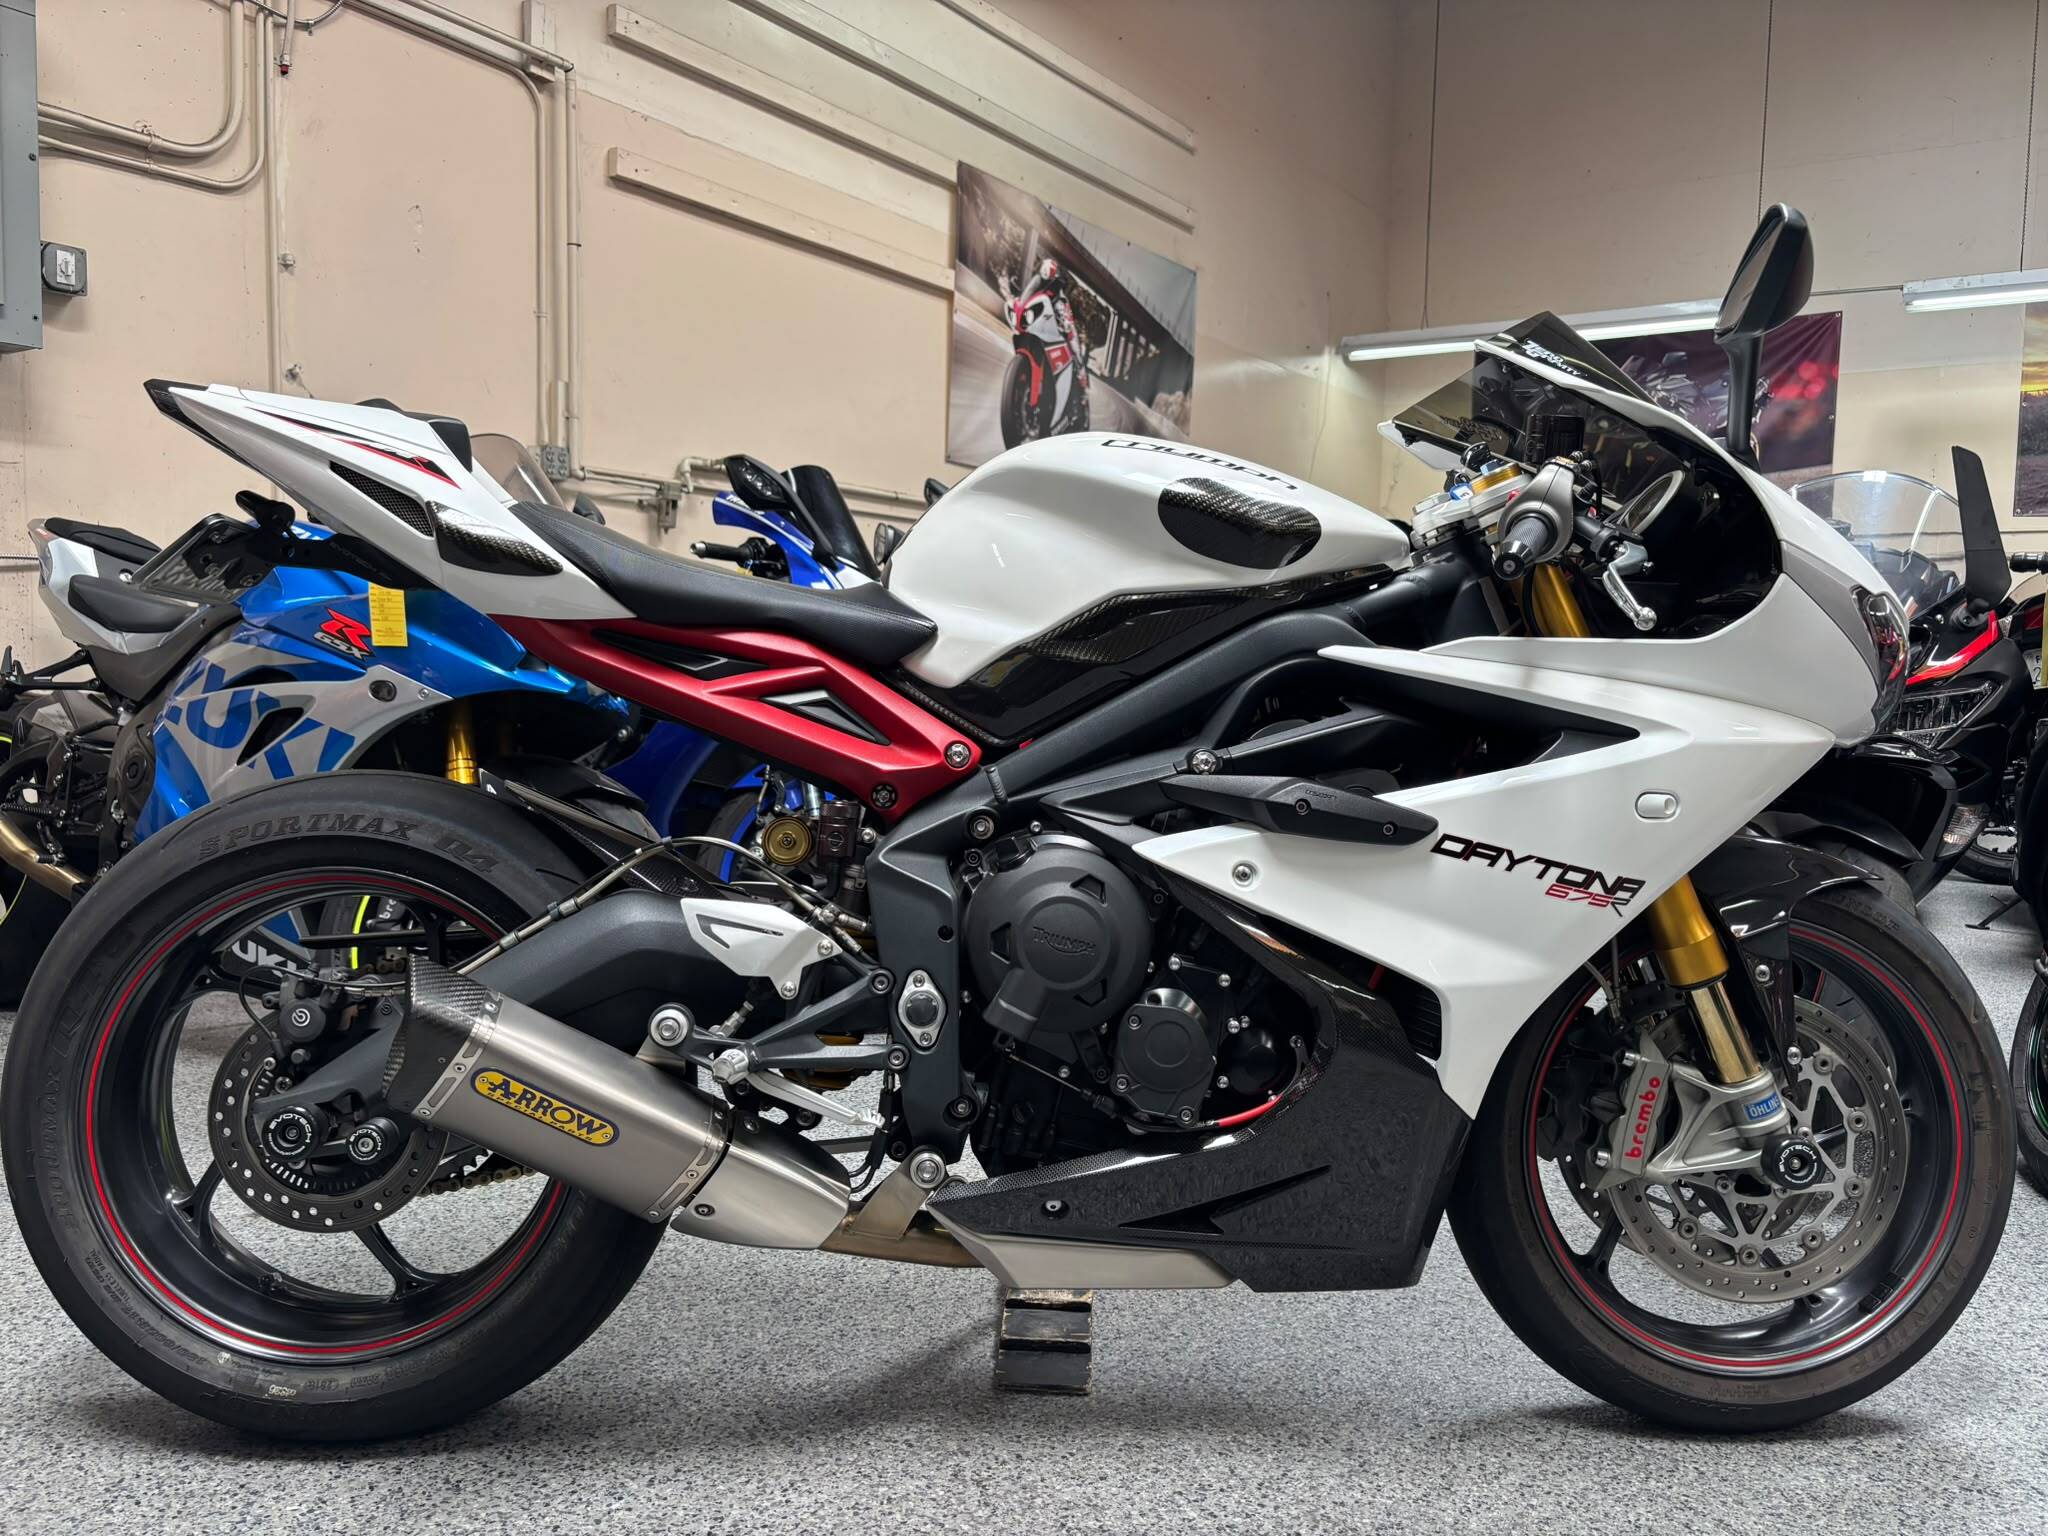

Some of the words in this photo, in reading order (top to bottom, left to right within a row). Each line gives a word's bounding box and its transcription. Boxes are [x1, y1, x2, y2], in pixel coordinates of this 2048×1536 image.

[200, 812, 419, 861] SPORTMAX
[1430, 833, 1646, 899] DAYTONA
[378, 898, 398, 920] bre
[1545, 883, 1631, 918] 675R
[1032, 925, 1098, 957] TRIUMPH
[487, 1078, 608, 1136] ARROW
[1624, 1075, 1662, 1161] brembo
[269, 1113, 312, 1143] EVOTECH
[349, 1128, 382, 1151] EVOTECH
[1779, 1144, 1817, 1172] EVOTECH
